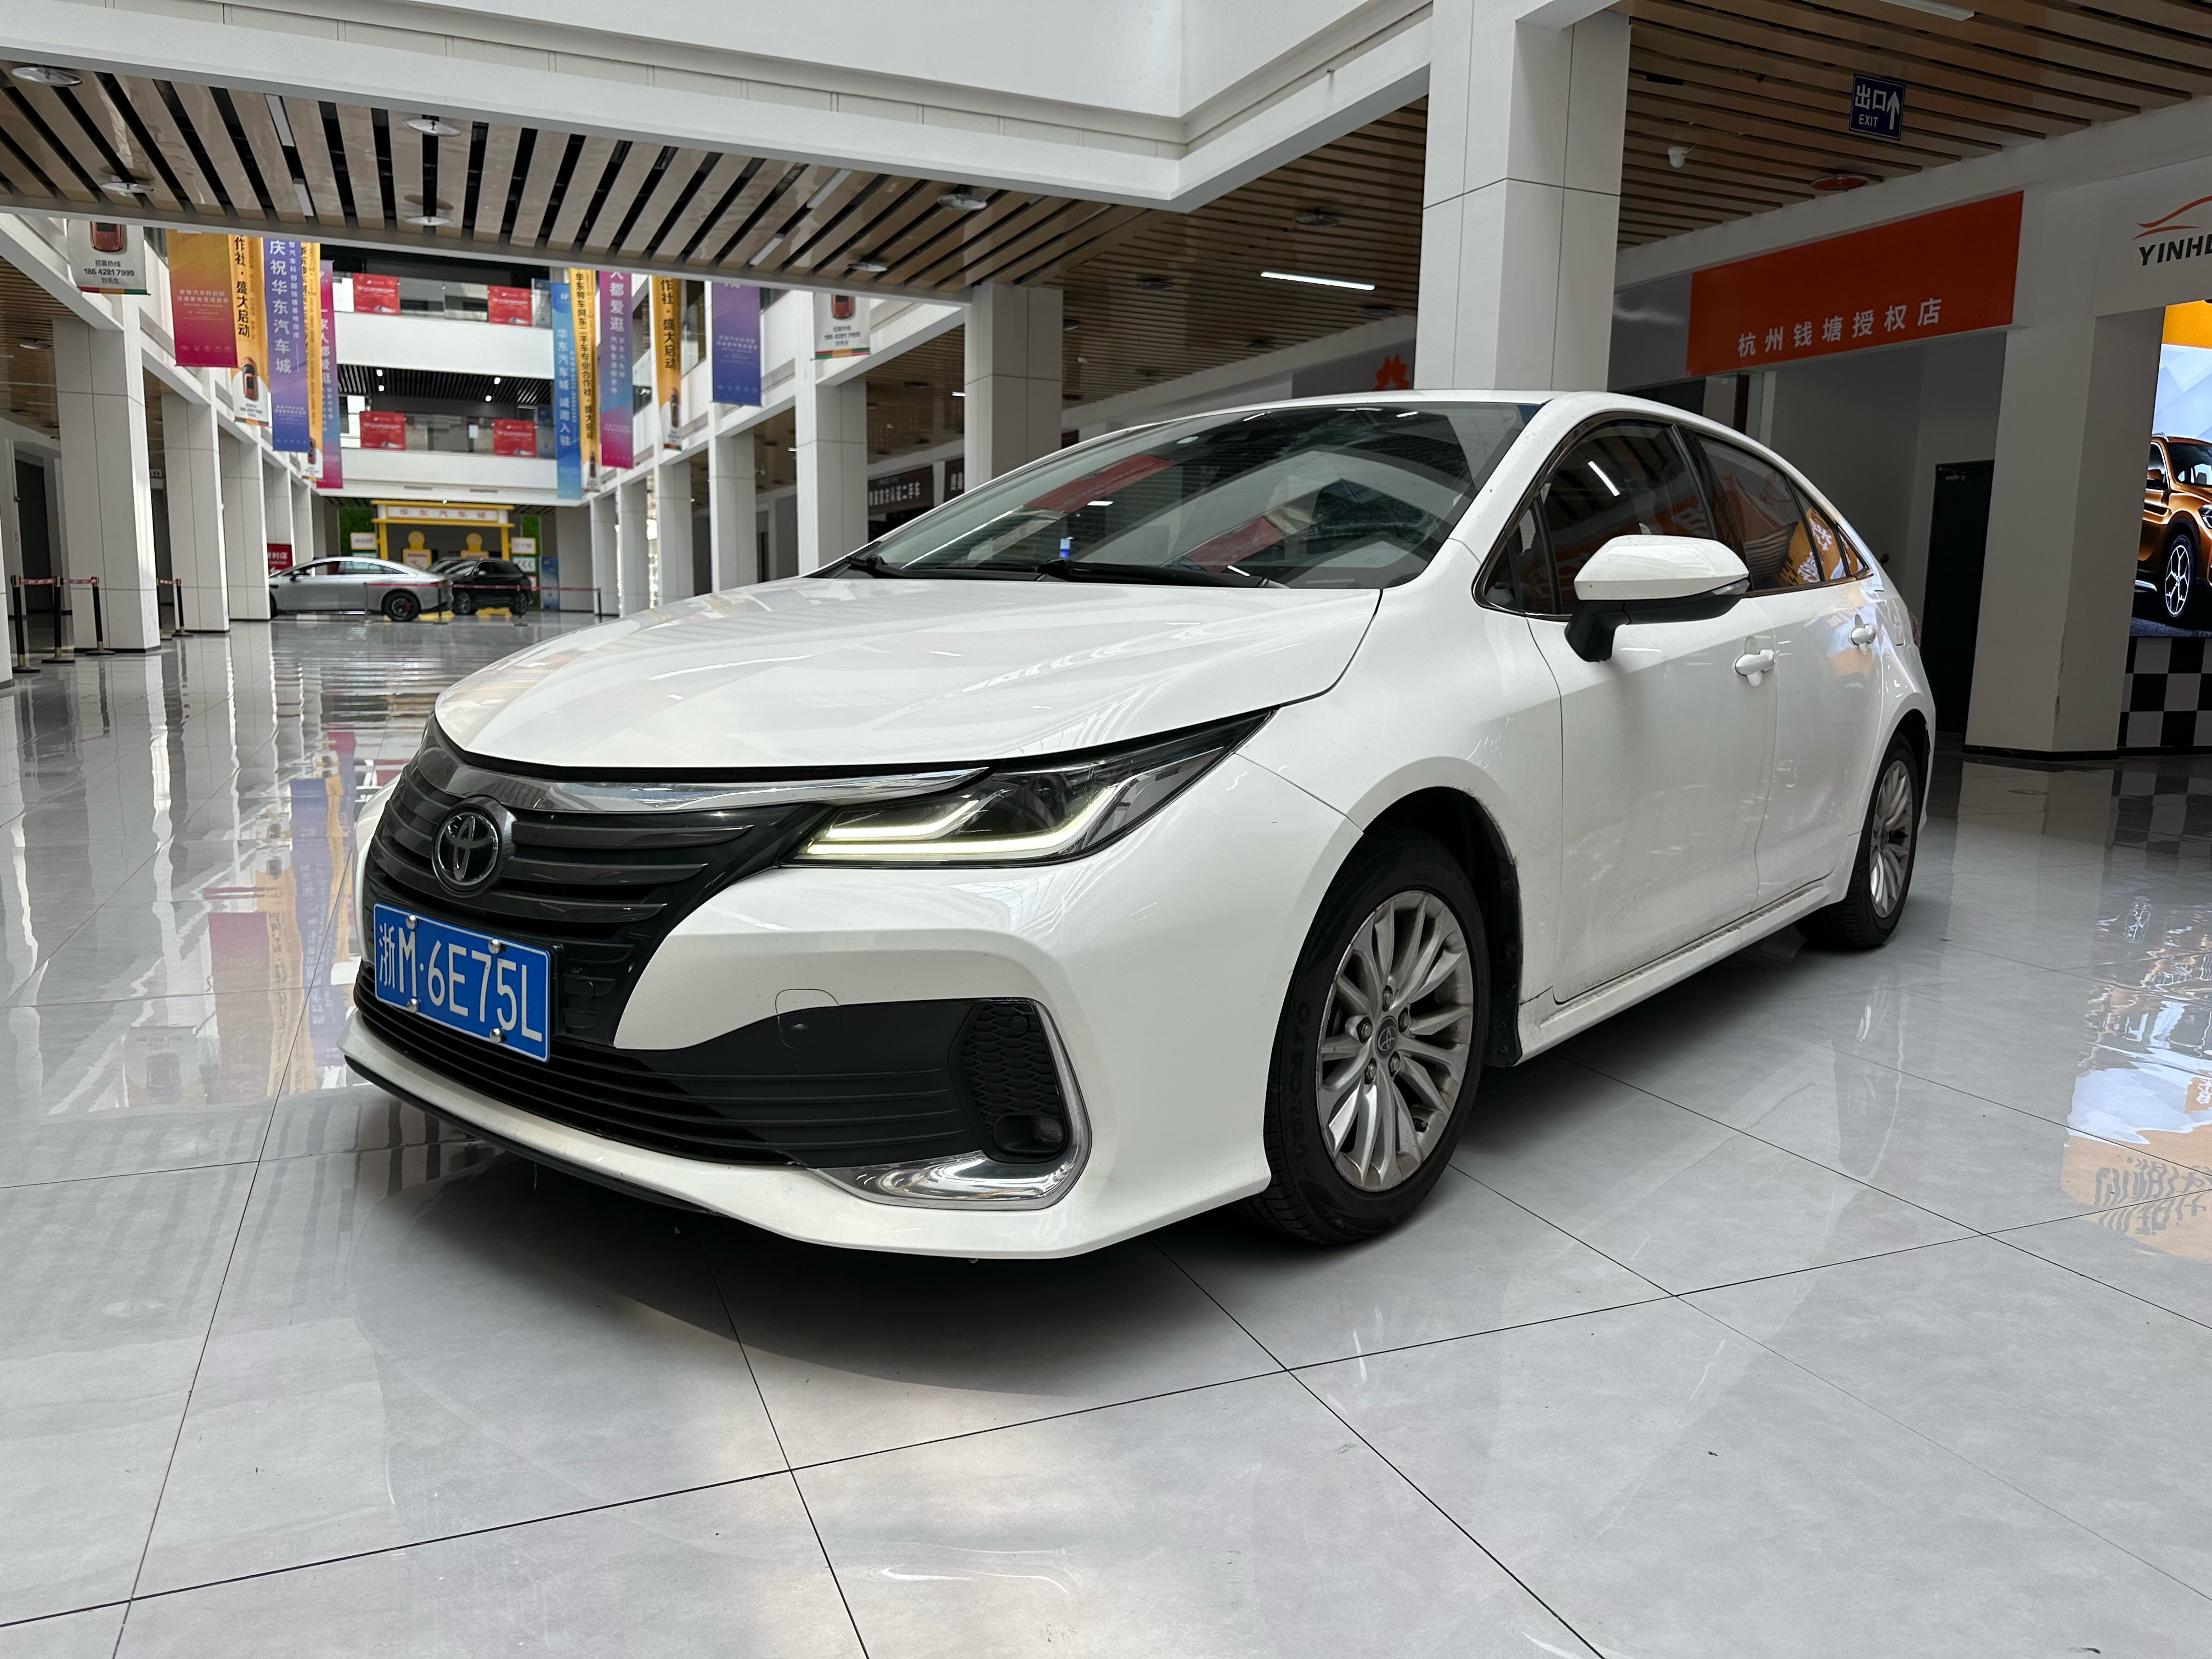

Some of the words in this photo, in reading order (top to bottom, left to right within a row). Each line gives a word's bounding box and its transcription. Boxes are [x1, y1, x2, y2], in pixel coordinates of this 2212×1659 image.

[1854, 84, 1887, 111] 出口
[1859, 114, 1878, 127] EXIT
[269, 240, 292, 374] 庆祝华东汽车城
[1737, 298, 1942, 358] 杭州钱塘授权店
